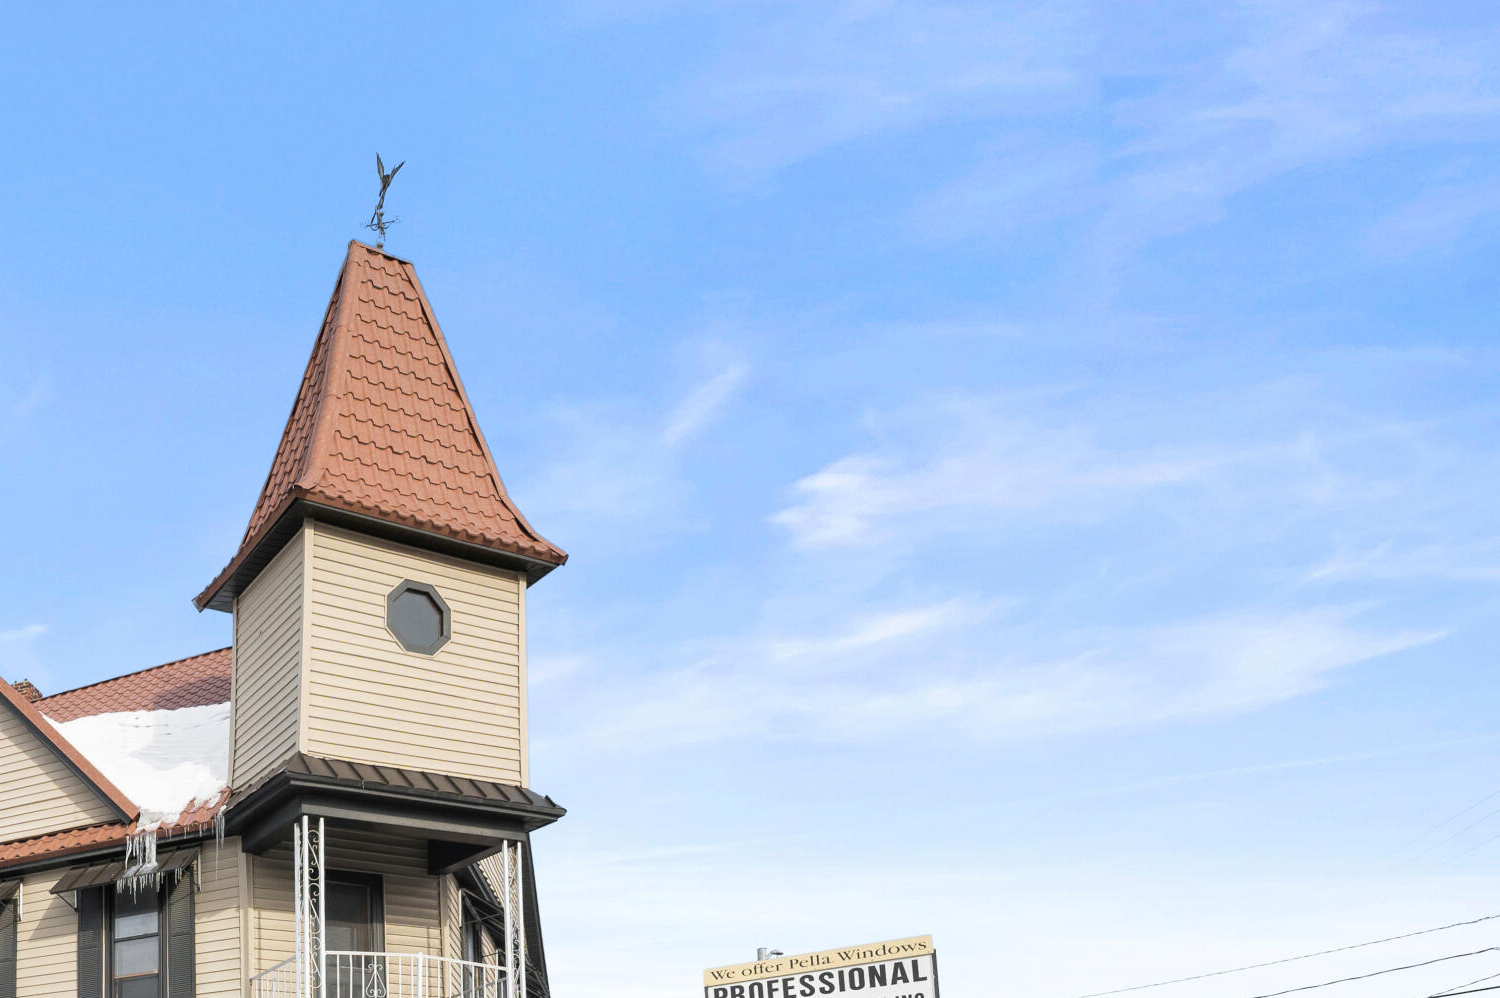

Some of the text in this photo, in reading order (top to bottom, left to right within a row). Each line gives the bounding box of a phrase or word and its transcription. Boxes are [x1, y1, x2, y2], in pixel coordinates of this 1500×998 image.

[711, 941, 928, 981] We offer Pella Windows
